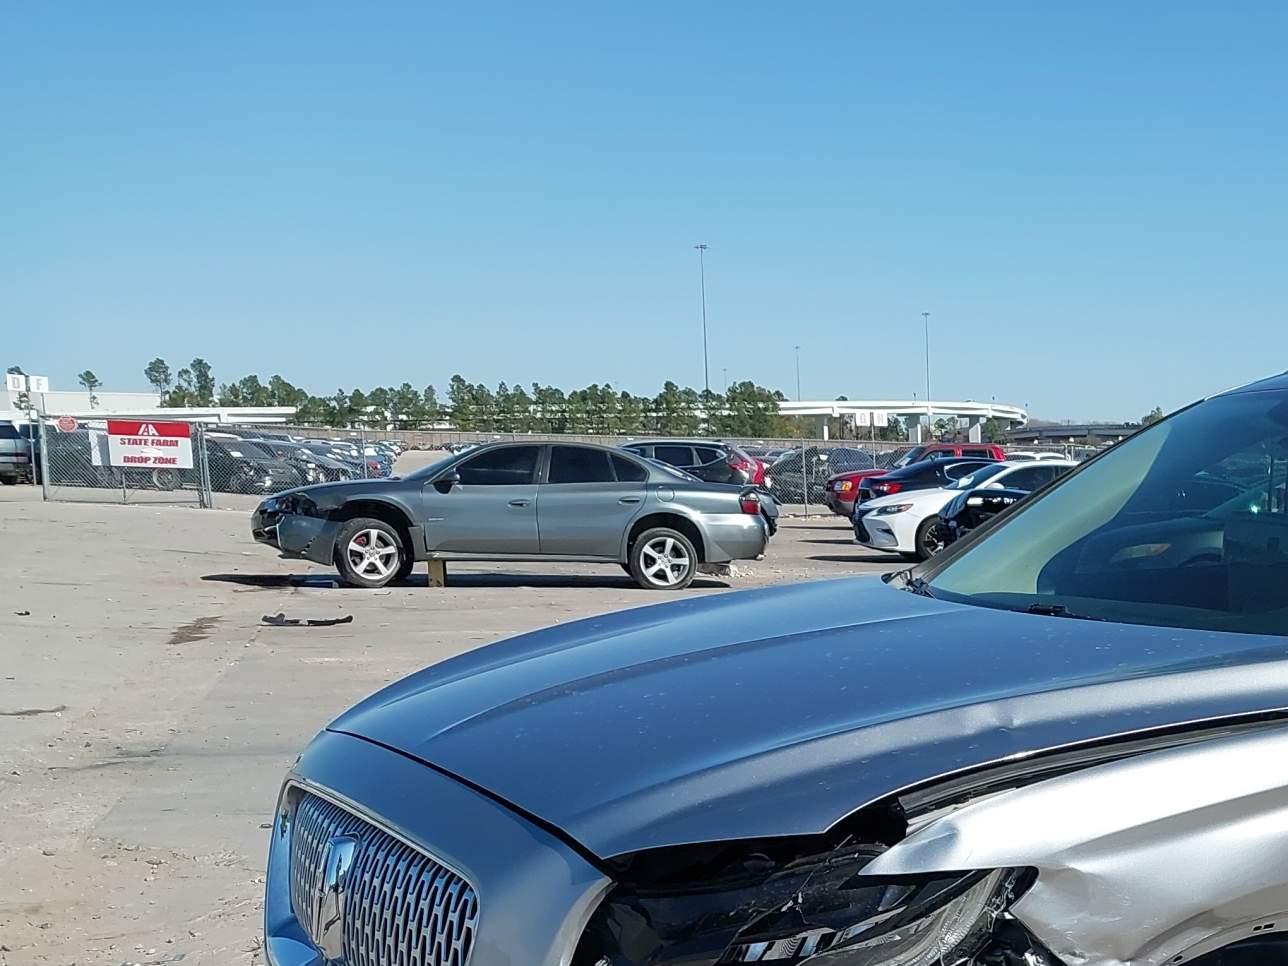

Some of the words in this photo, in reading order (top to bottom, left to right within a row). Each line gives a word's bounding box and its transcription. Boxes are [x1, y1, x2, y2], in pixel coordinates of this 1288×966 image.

[120, 438, 150, 446] STATE
[151, 438, 179, 447] FARM
[123, 455, 151, 464] DROP
[153, 456, 178, 465] ZONE
